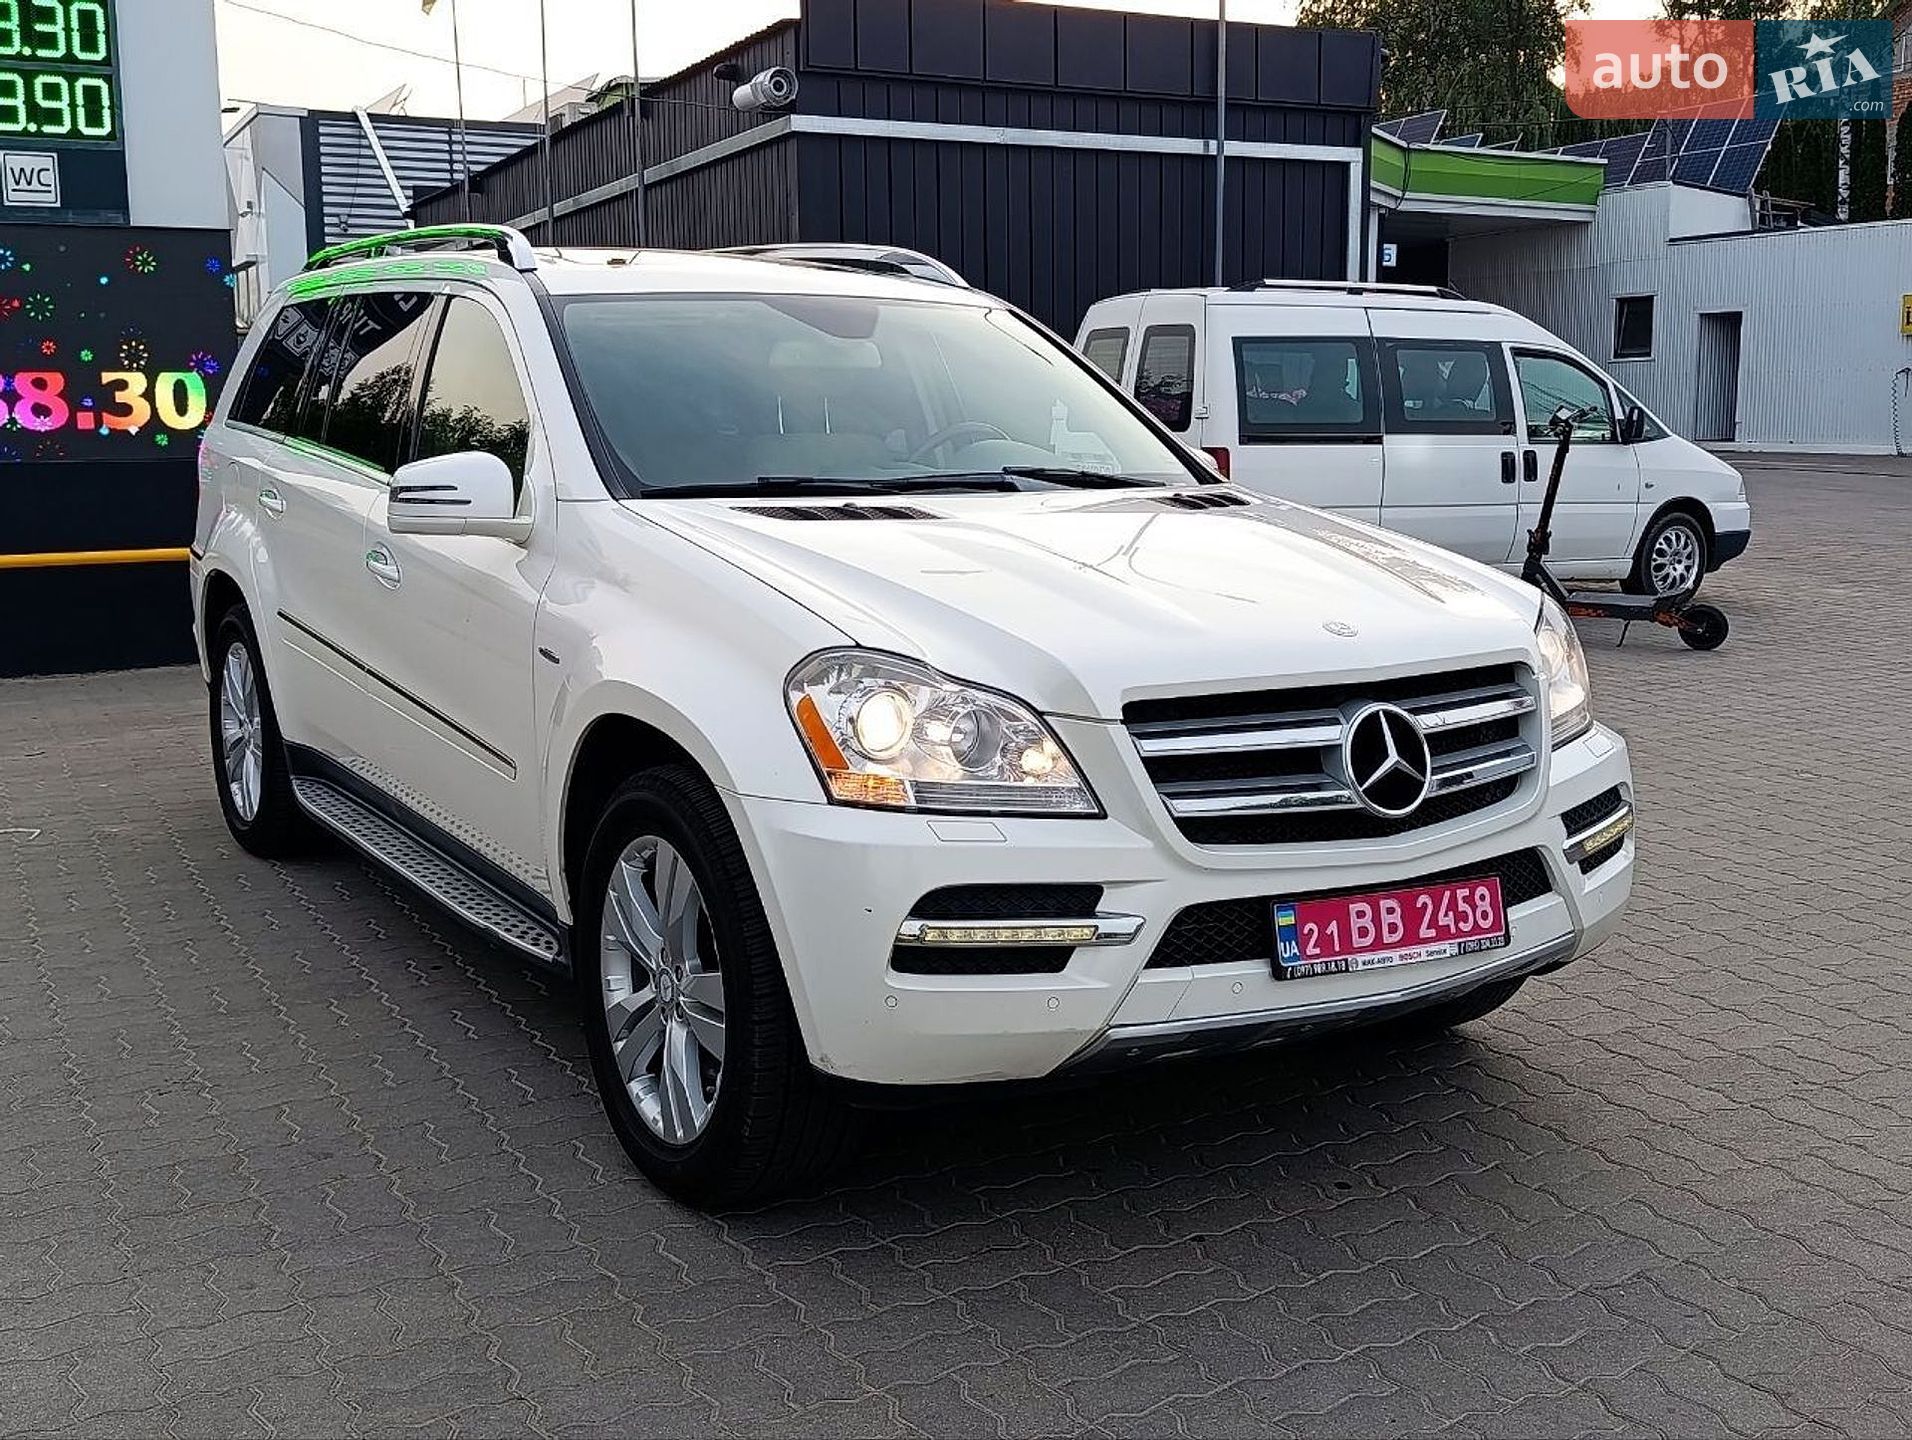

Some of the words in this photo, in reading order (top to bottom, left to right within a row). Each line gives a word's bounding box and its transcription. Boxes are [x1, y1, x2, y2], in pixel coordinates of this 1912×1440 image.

[10, 167, 52, 187] WC
[0, 371, 206, 431] 8.30
[1303, 919, 1340, 956] 21
[1349, 899, 1404, 948] BB
[1416, 886, 1494, 938] 2458
[1281, 940, 1299, 958] UA
[1398, 951, 1422, 961] BOSCH
[1425, 948, 1448, 958] Service
